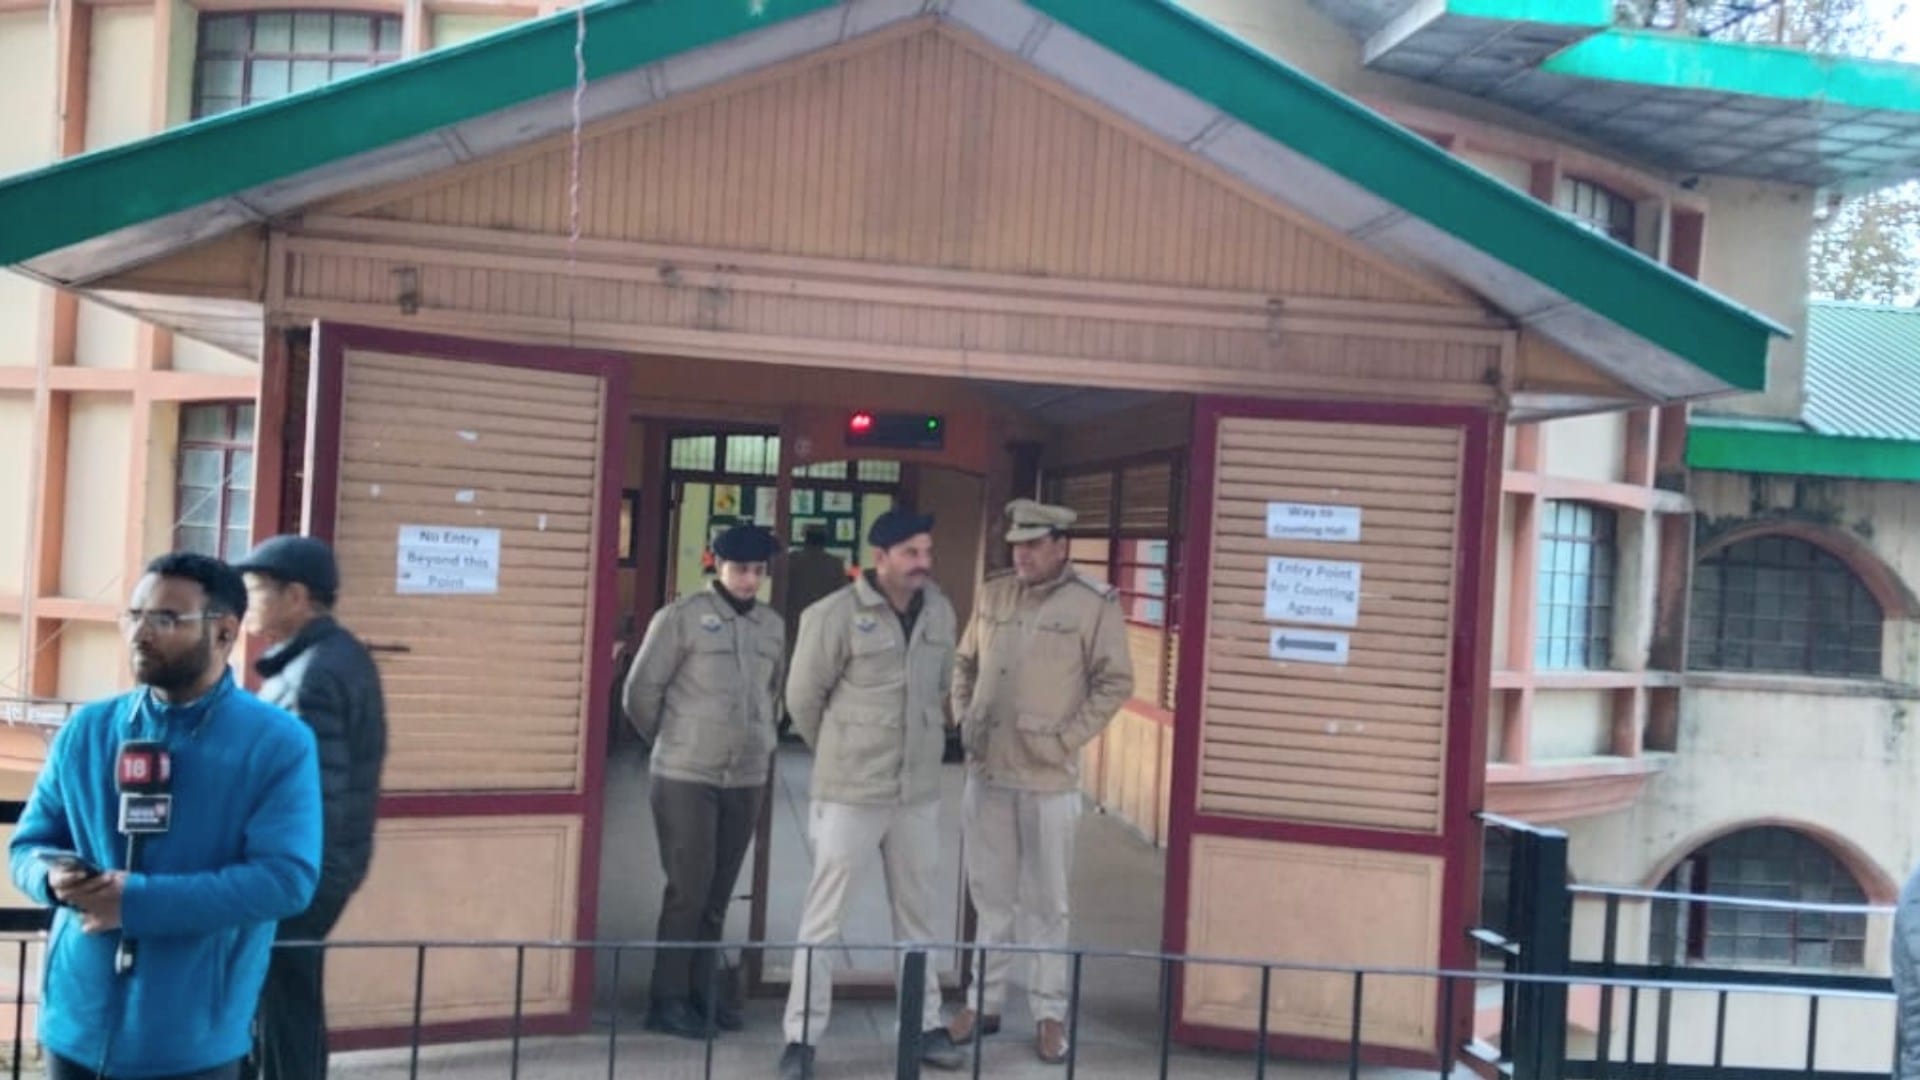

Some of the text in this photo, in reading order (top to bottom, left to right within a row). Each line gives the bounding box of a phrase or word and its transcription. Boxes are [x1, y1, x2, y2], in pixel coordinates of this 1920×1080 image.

[444, 532, 480, 547] Entry
[1276, 561, 1353, 580] Entry Point
[1271, 578, 1355, 602] for Counting
[1289, 601, 1334, 616] Agents
[123, 757, 147, 779] 18
